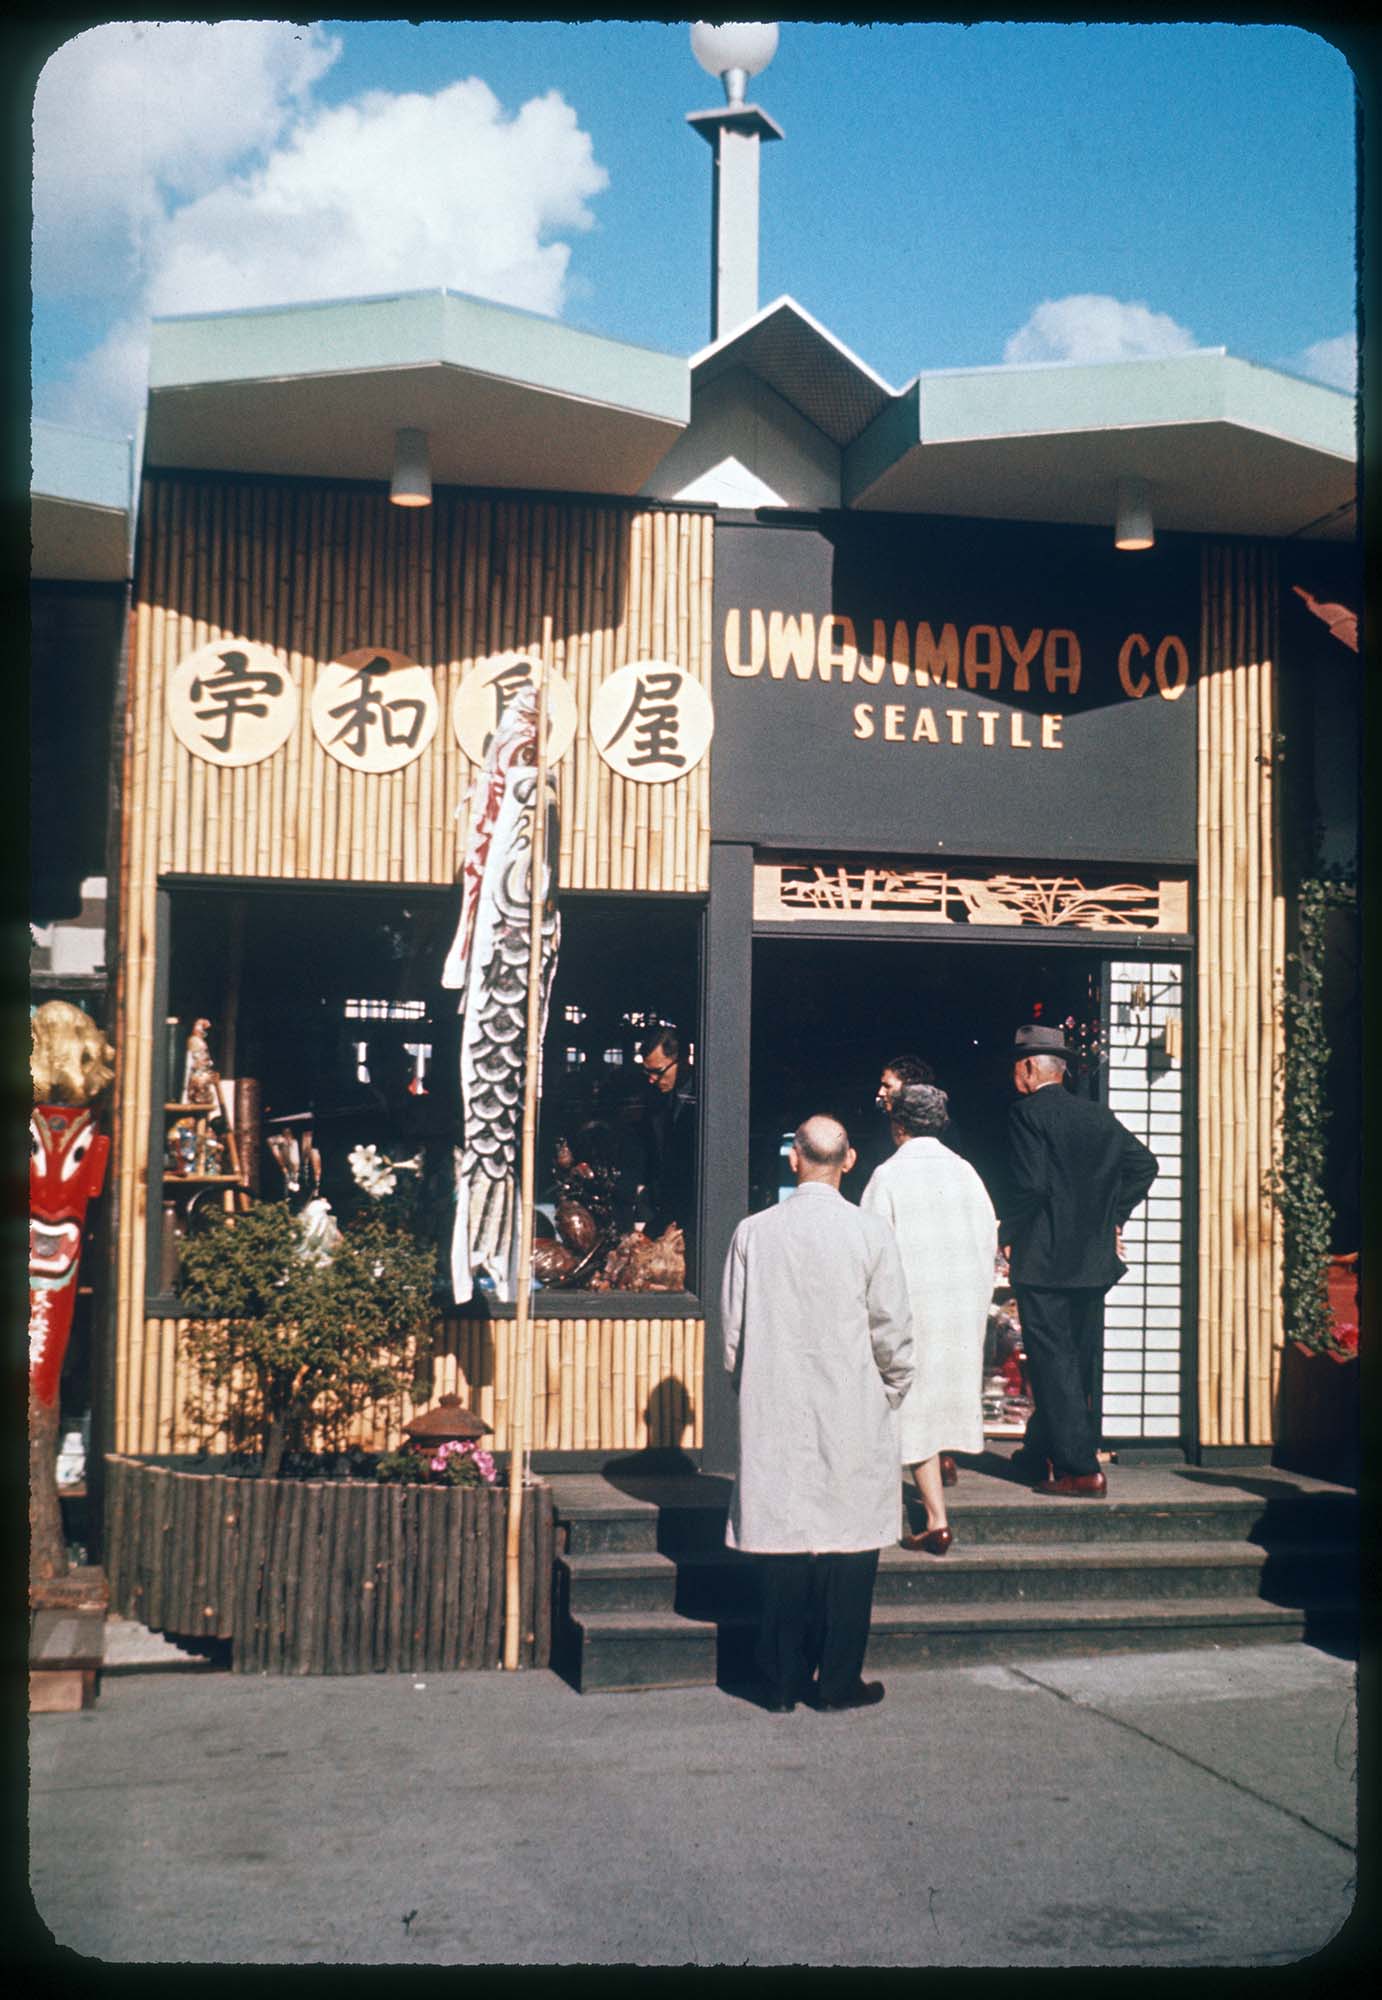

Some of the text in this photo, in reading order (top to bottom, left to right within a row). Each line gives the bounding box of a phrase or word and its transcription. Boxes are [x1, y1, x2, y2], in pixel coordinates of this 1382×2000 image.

[725, 608, 1190, 700] UWAJIMAYA CO
[853, 702, 1064, 749] SEATTLE
